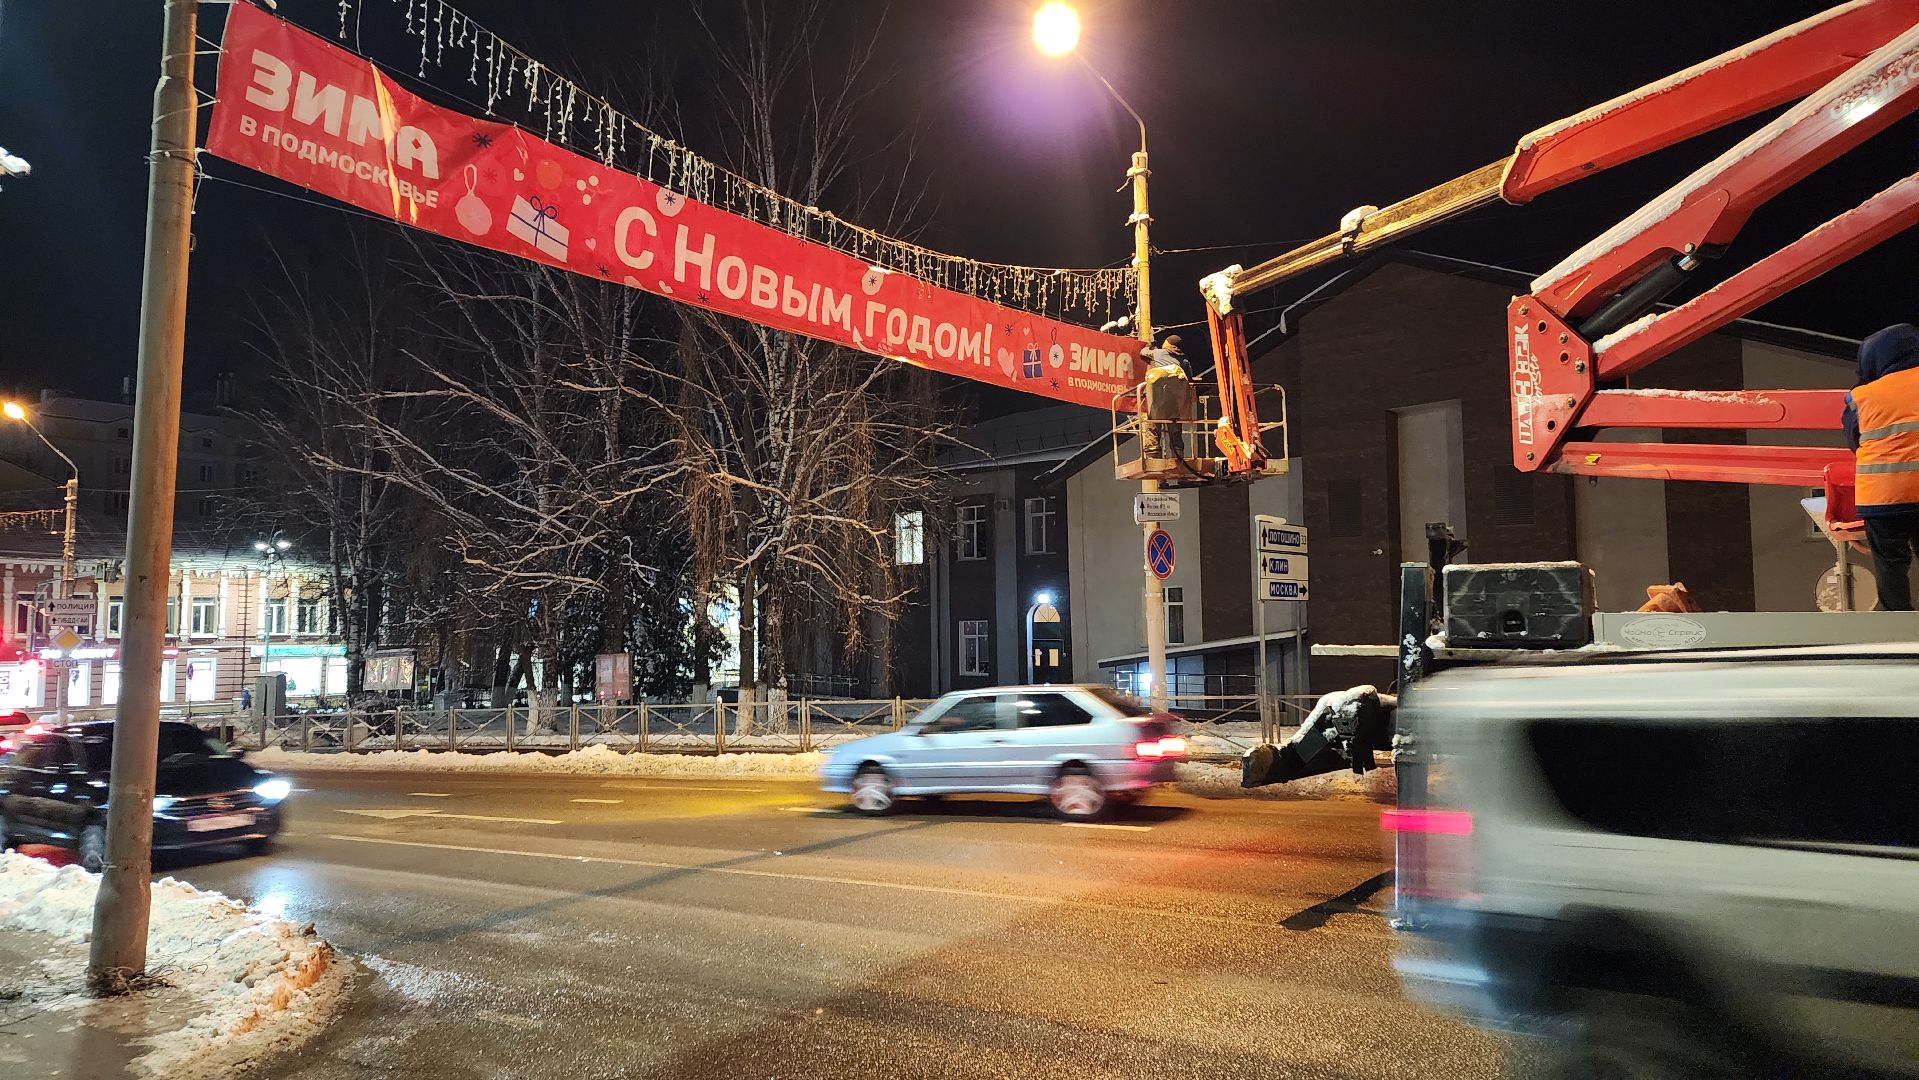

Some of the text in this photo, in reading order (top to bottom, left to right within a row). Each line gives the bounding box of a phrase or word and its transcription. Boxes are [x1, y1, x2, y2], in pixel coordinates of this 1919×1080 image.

[245, 48, 439, 179] ЗИМА
[262, 124, 439, 208] ПОДМОСКВЬЕ
[1069, 342, 1134, 379] ЗИМА
[1269, 531, 1299, 545] ЛОТОШИНО
[1270, 559, 1288, 572] КЛИН
[1270, 583, 1298, 596] МОСКВА
[56, 603, 95, 611] ПОЛИЦИЯ
[54, 660, 79, 668] СТОП
